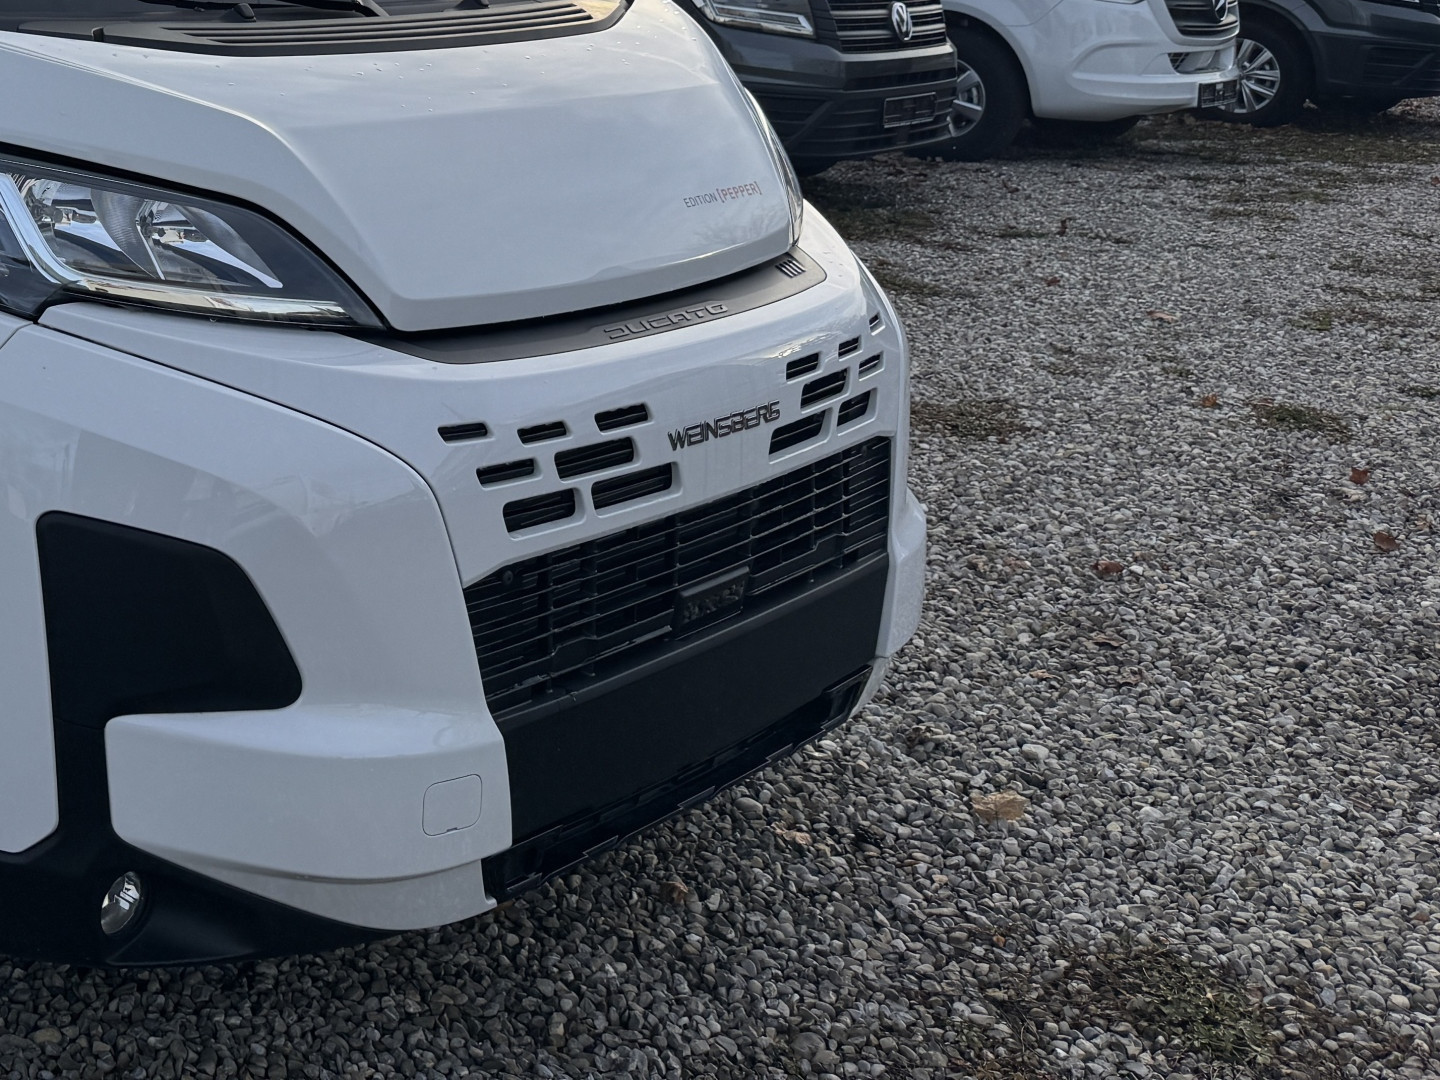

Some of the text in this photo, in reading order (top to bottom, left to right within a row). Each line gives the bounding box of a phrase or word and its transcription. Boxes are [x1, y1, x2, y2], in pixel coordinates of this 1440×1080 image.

[683, 181, 763, 208] EDITION [PEPPER]
[603, 303, 729, 340] DUCATO
[667, 399, 781, 452] WEINSBERG
